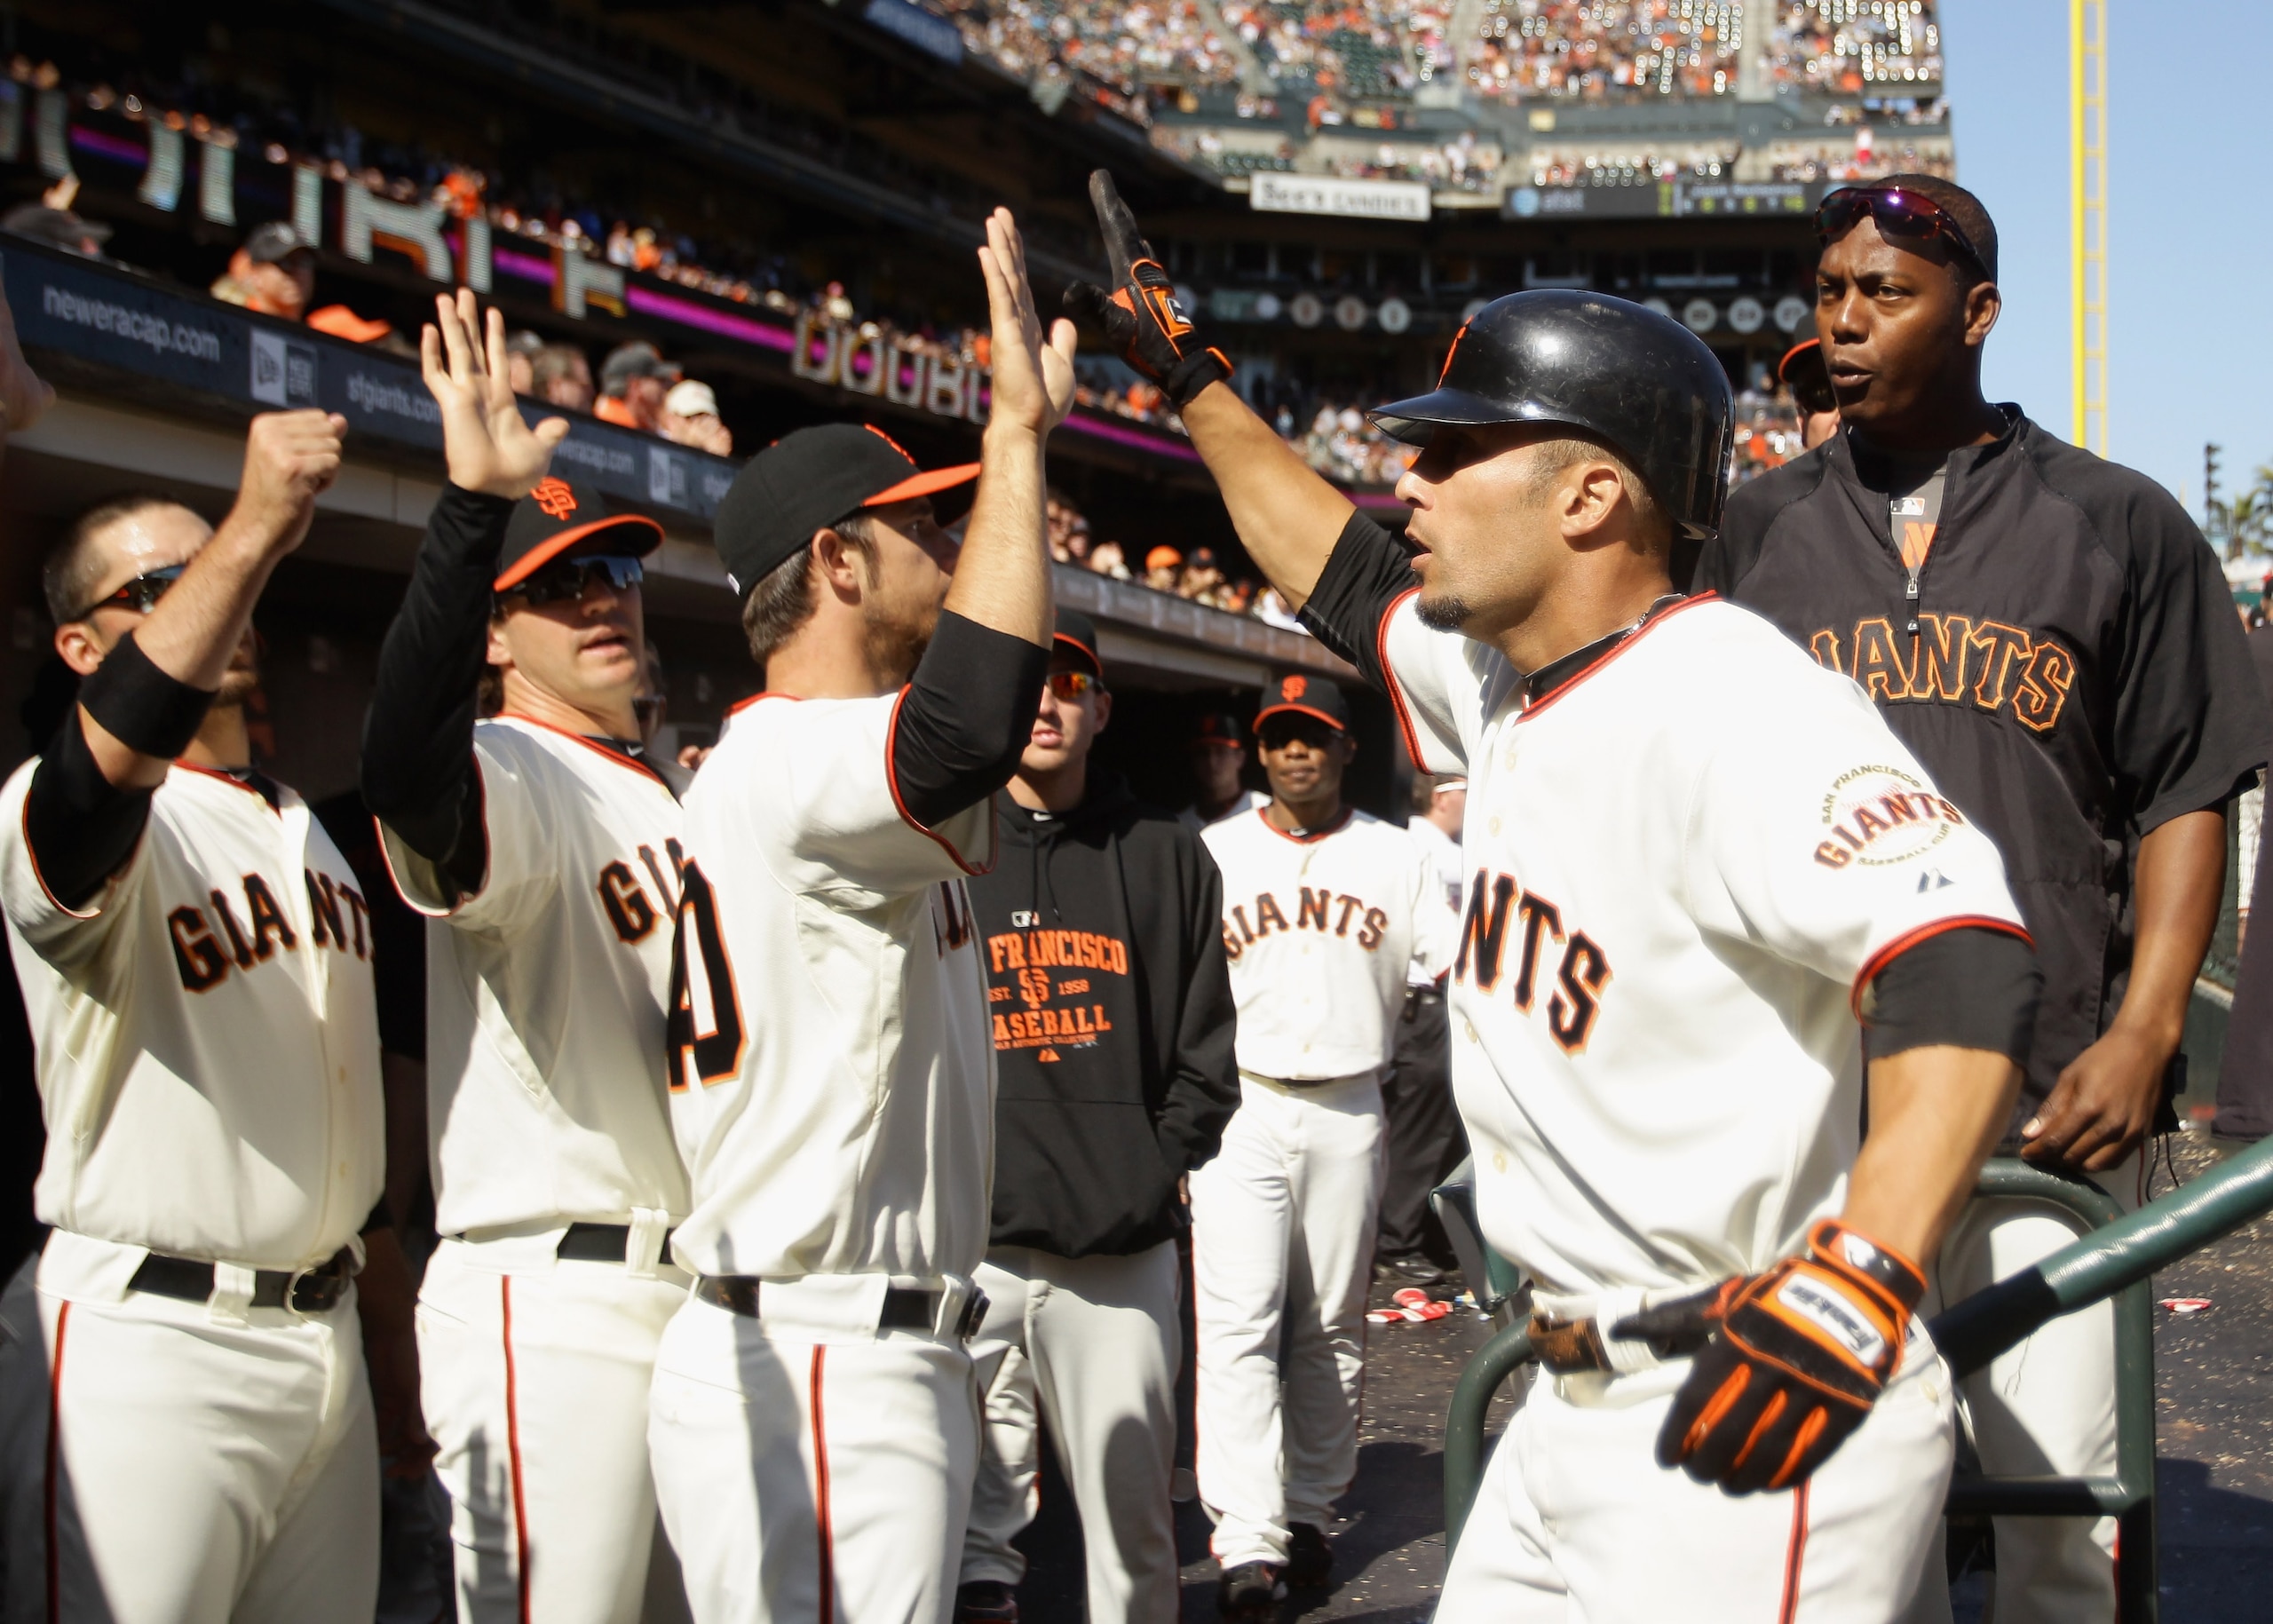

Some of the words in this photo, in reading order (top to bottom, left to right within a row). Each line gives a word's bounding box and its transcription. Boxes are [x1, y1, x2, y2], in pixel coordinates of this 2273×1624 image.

[43, 283, 221, 362] neweracap.com
[1813, 792, 1964, 869] GIANTS
[1822, 793, 1836, 825] SAN
[1833, 764, 1921, 790] FRANCISCO
[167, 867, 376, 995] GIANT
[987, 930, 1129, 975] FRANCISCO
